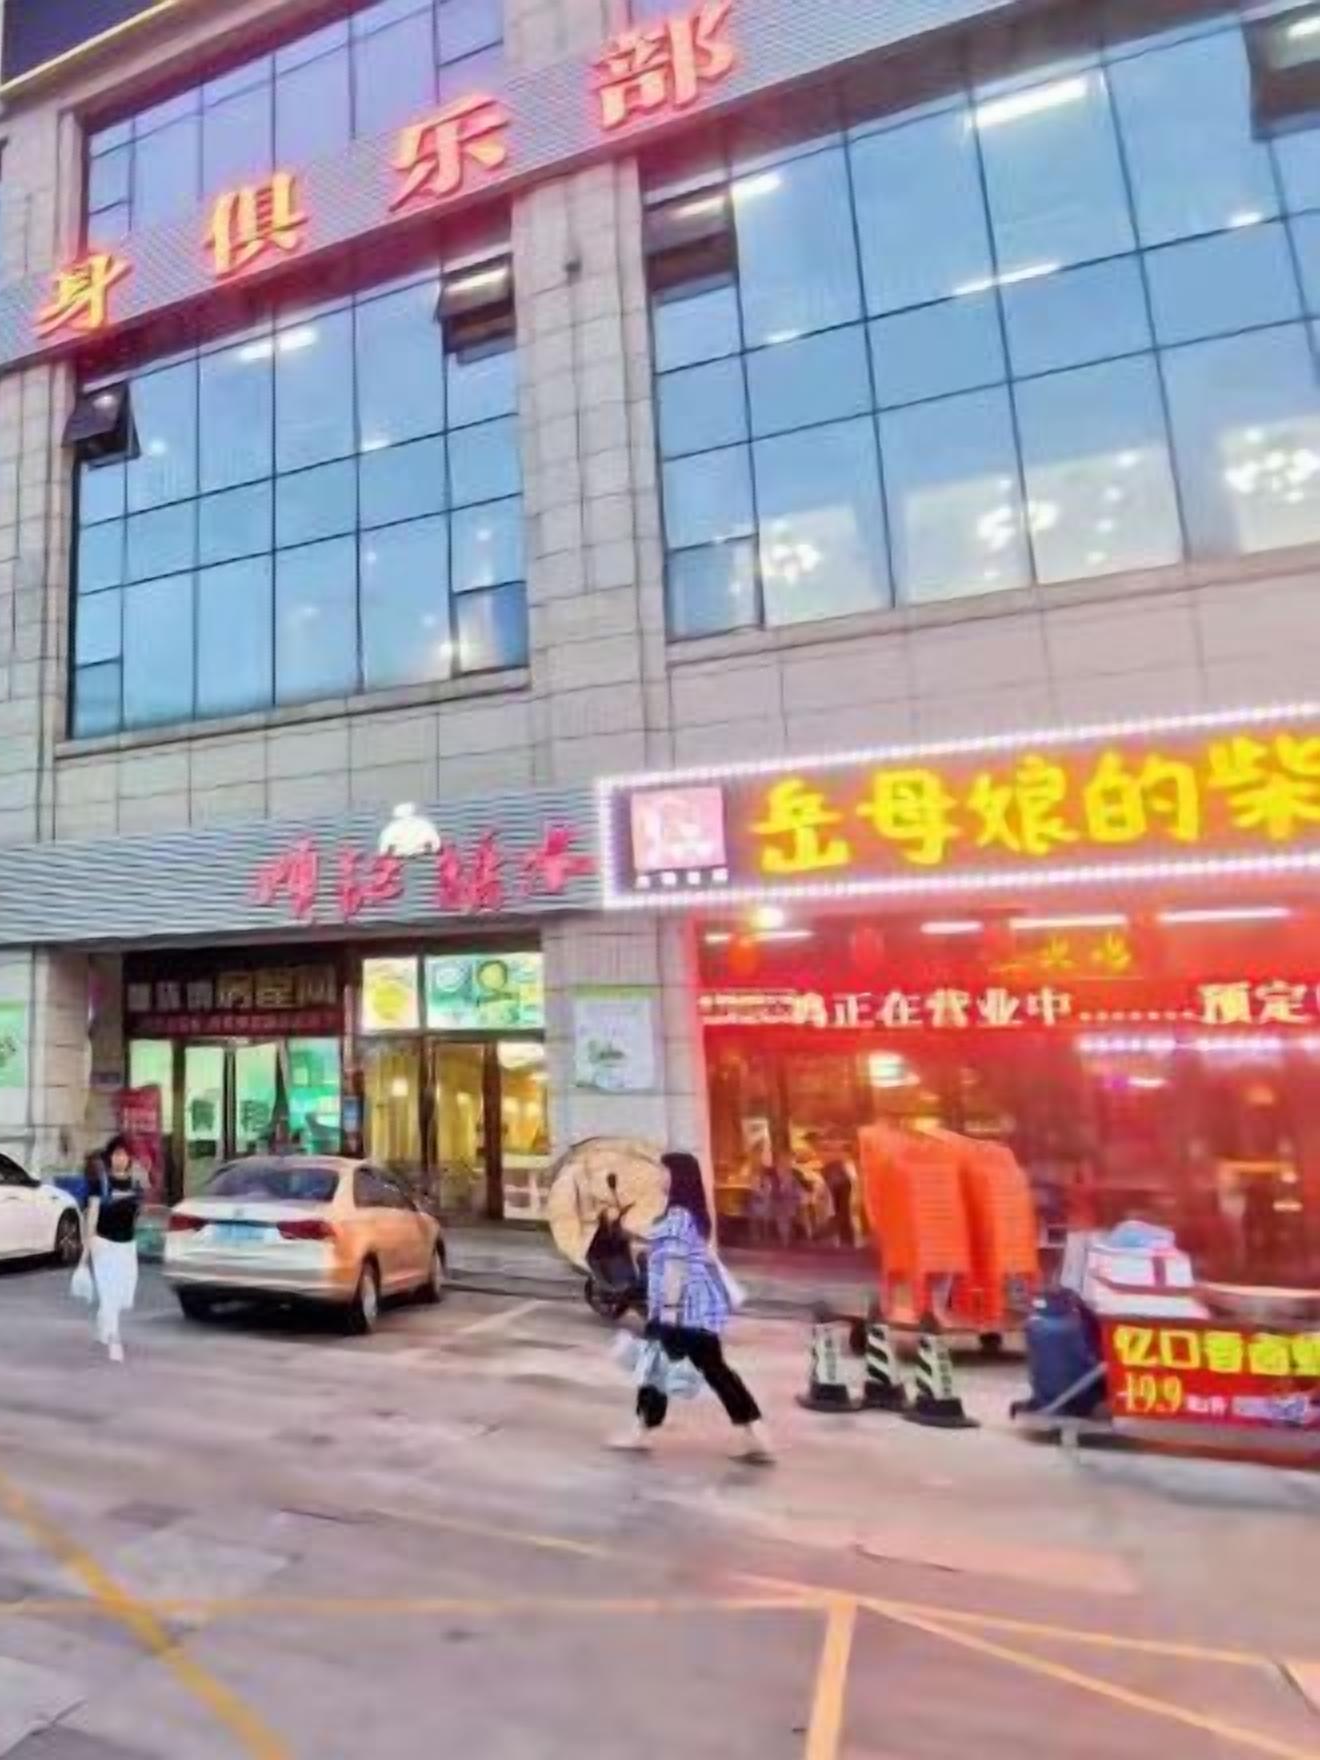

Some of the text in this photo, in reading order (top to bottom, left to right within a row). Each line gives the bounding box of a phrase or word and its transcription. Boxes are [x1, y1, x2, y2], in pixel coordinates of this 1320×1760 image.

[752, 732, 1320, 874] 岳母娘的柴
